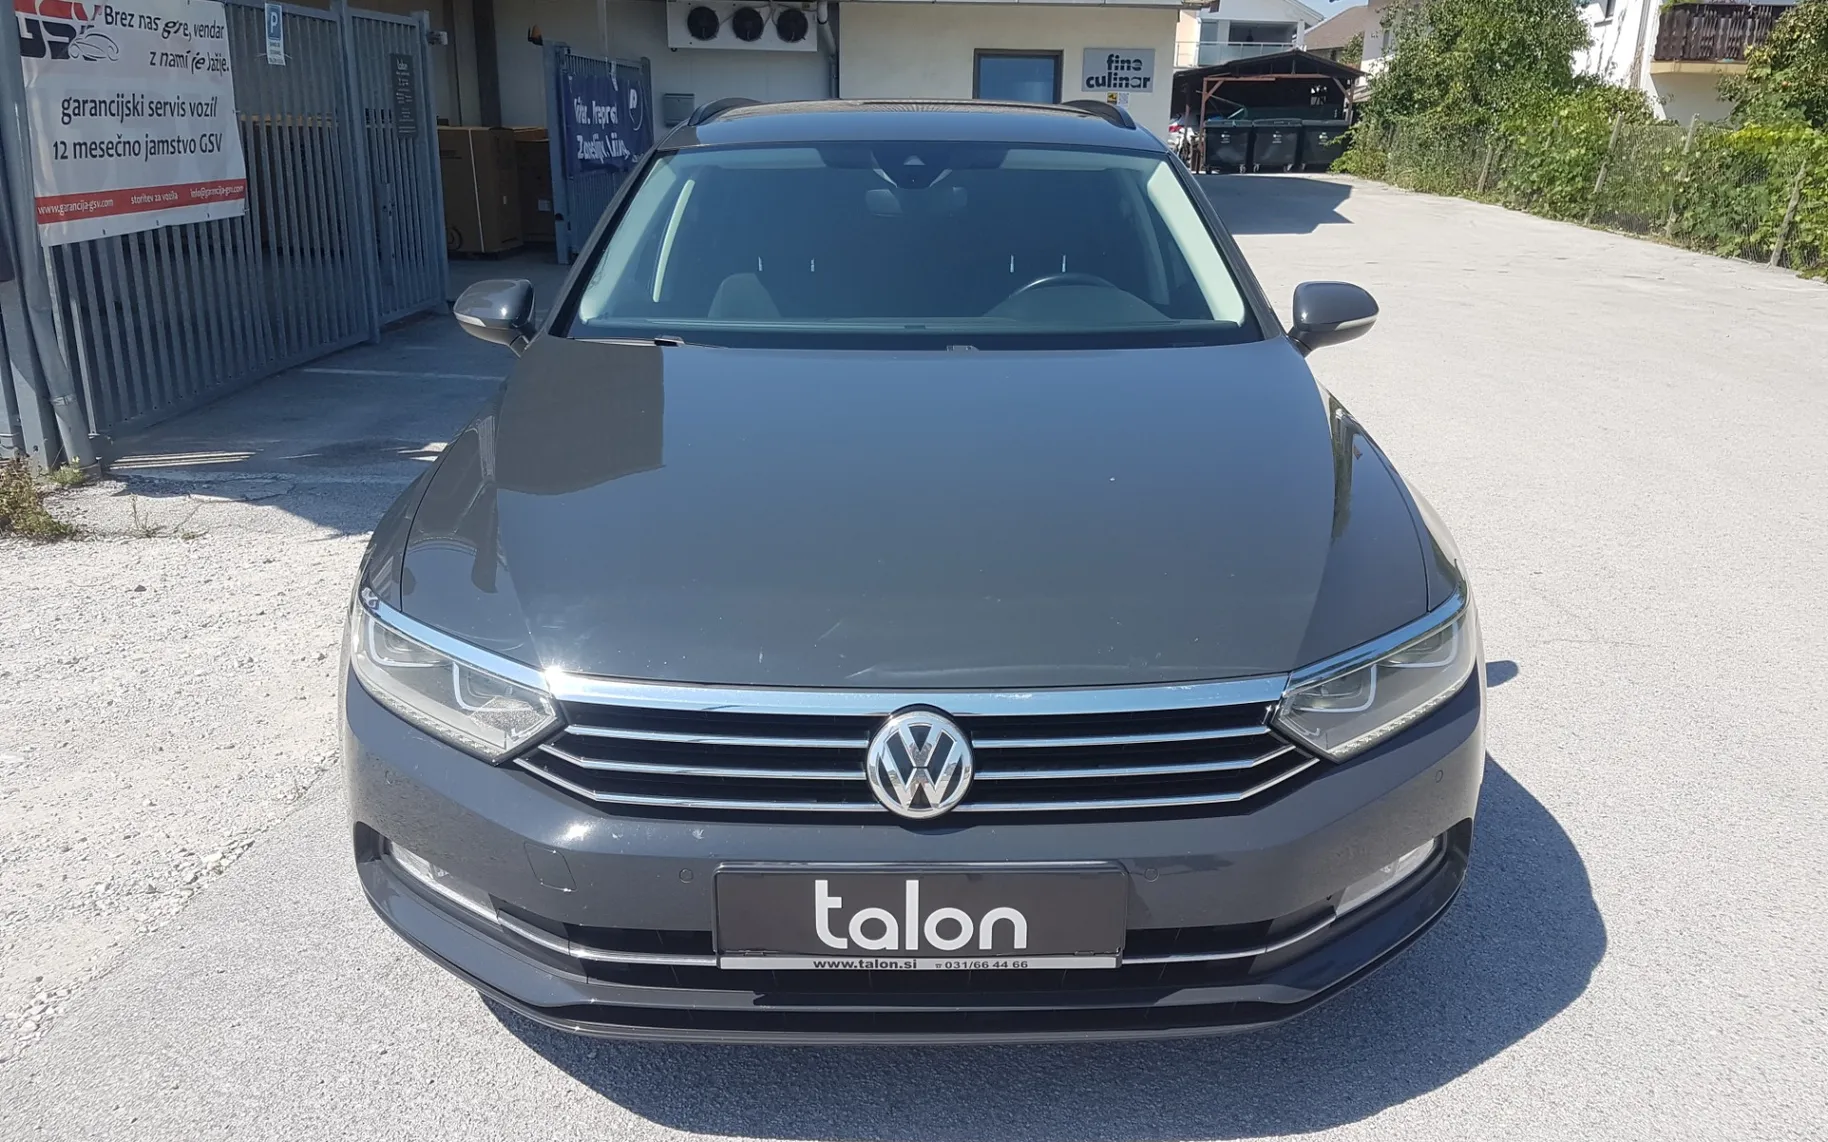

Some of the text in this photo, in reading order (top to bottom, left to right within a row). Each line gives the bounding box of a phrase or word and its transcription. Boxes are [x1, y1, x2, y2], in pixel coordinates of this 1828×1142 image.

[104, 5, 224, 42] Brez nas gre, vendar
[270, 11, 278, 33] P
[149, 51, 157, 66] z
[160, 50, 191, 69] nami
[1106, 54, 1143, 71] fine
[1085, 72, 1151, 89] culinar
[61, 93, 218, 125] garancijski servis vozil
[53, 133, 223, 162] 12 mesečno jamstvo GSV
[38, 198, 114, 216] www.garancija-gsv.com
[815, 879, 1027, 951] talon
[813, 959, 1028, 969] www.talon.si 031/66 44 66
